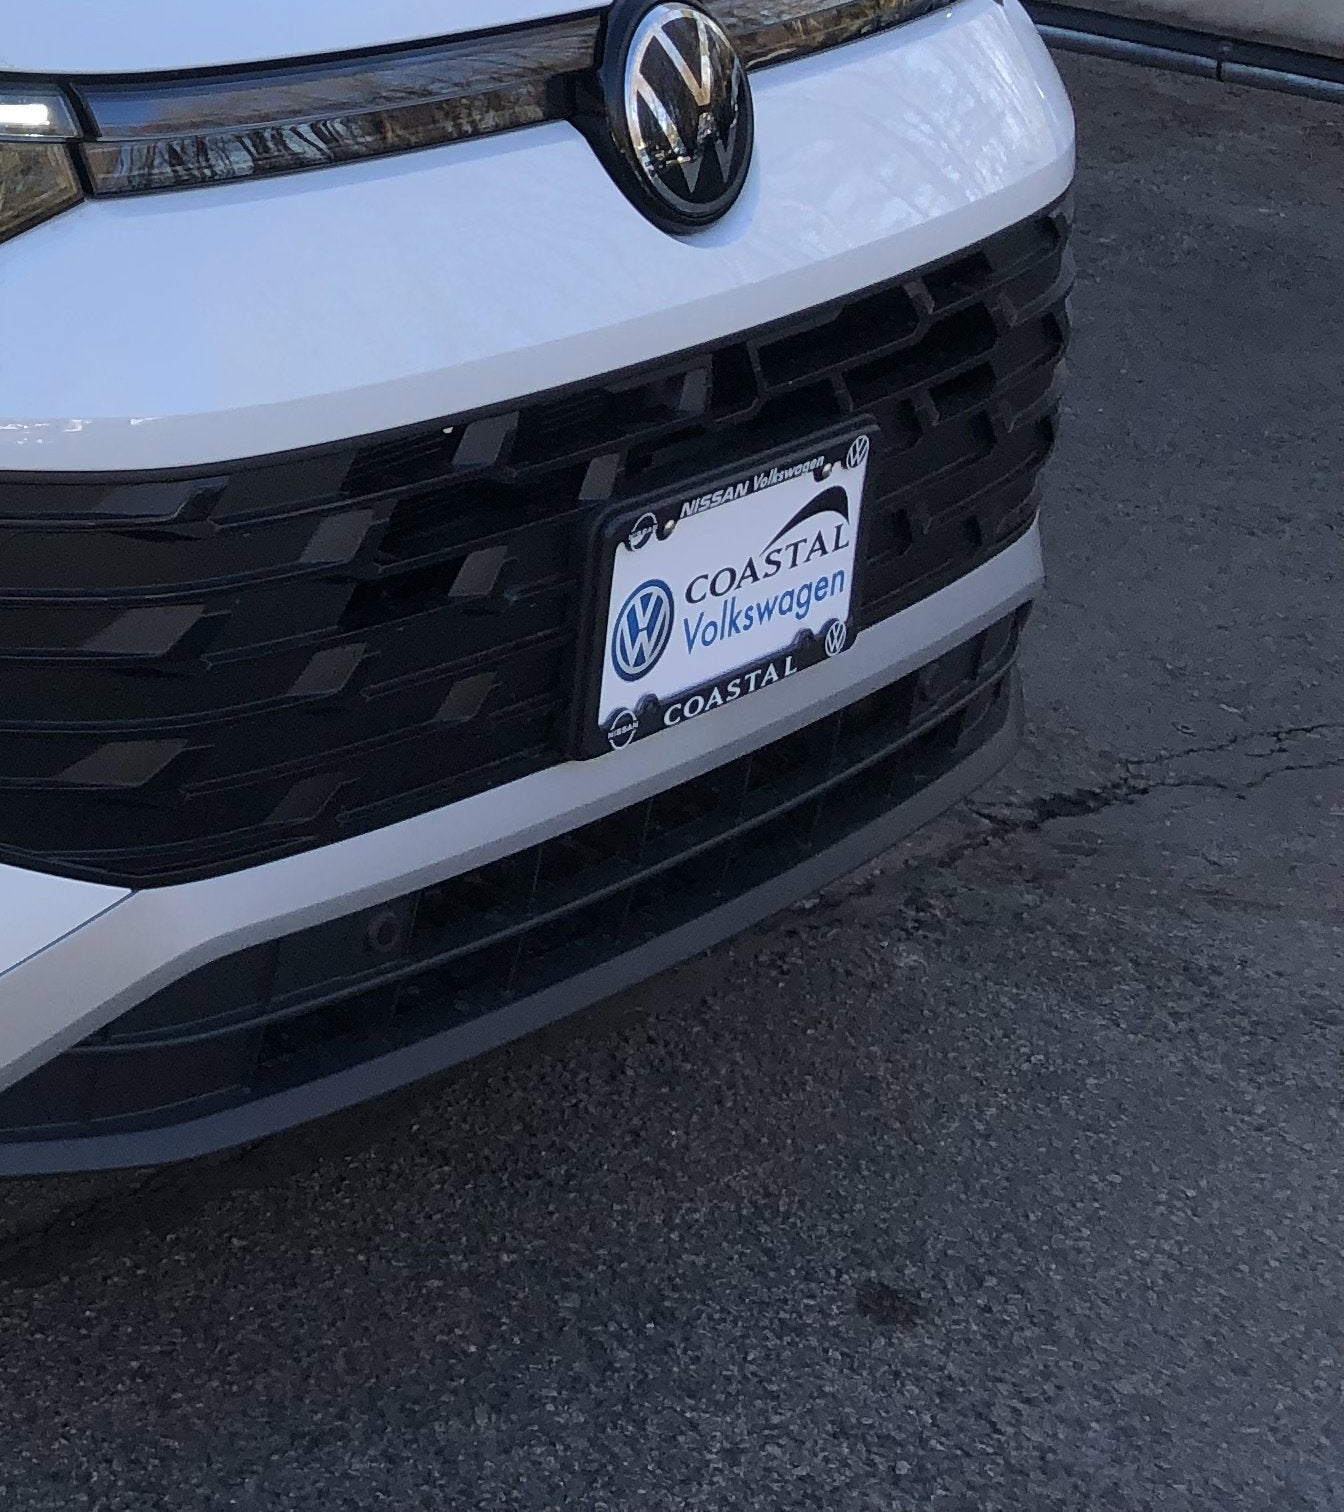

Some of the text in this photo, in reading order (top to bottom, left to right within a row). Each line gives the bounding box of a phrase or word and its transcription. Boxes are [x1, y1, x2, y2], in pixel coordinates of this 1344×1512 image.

[680, 456, 825, 518] NISSAN Volkswagen
[685, 524, 850, 604] COASTAL
[683, 569, 845, 655] Volkswagen
[663, 656, 798, 726] COASTAL
